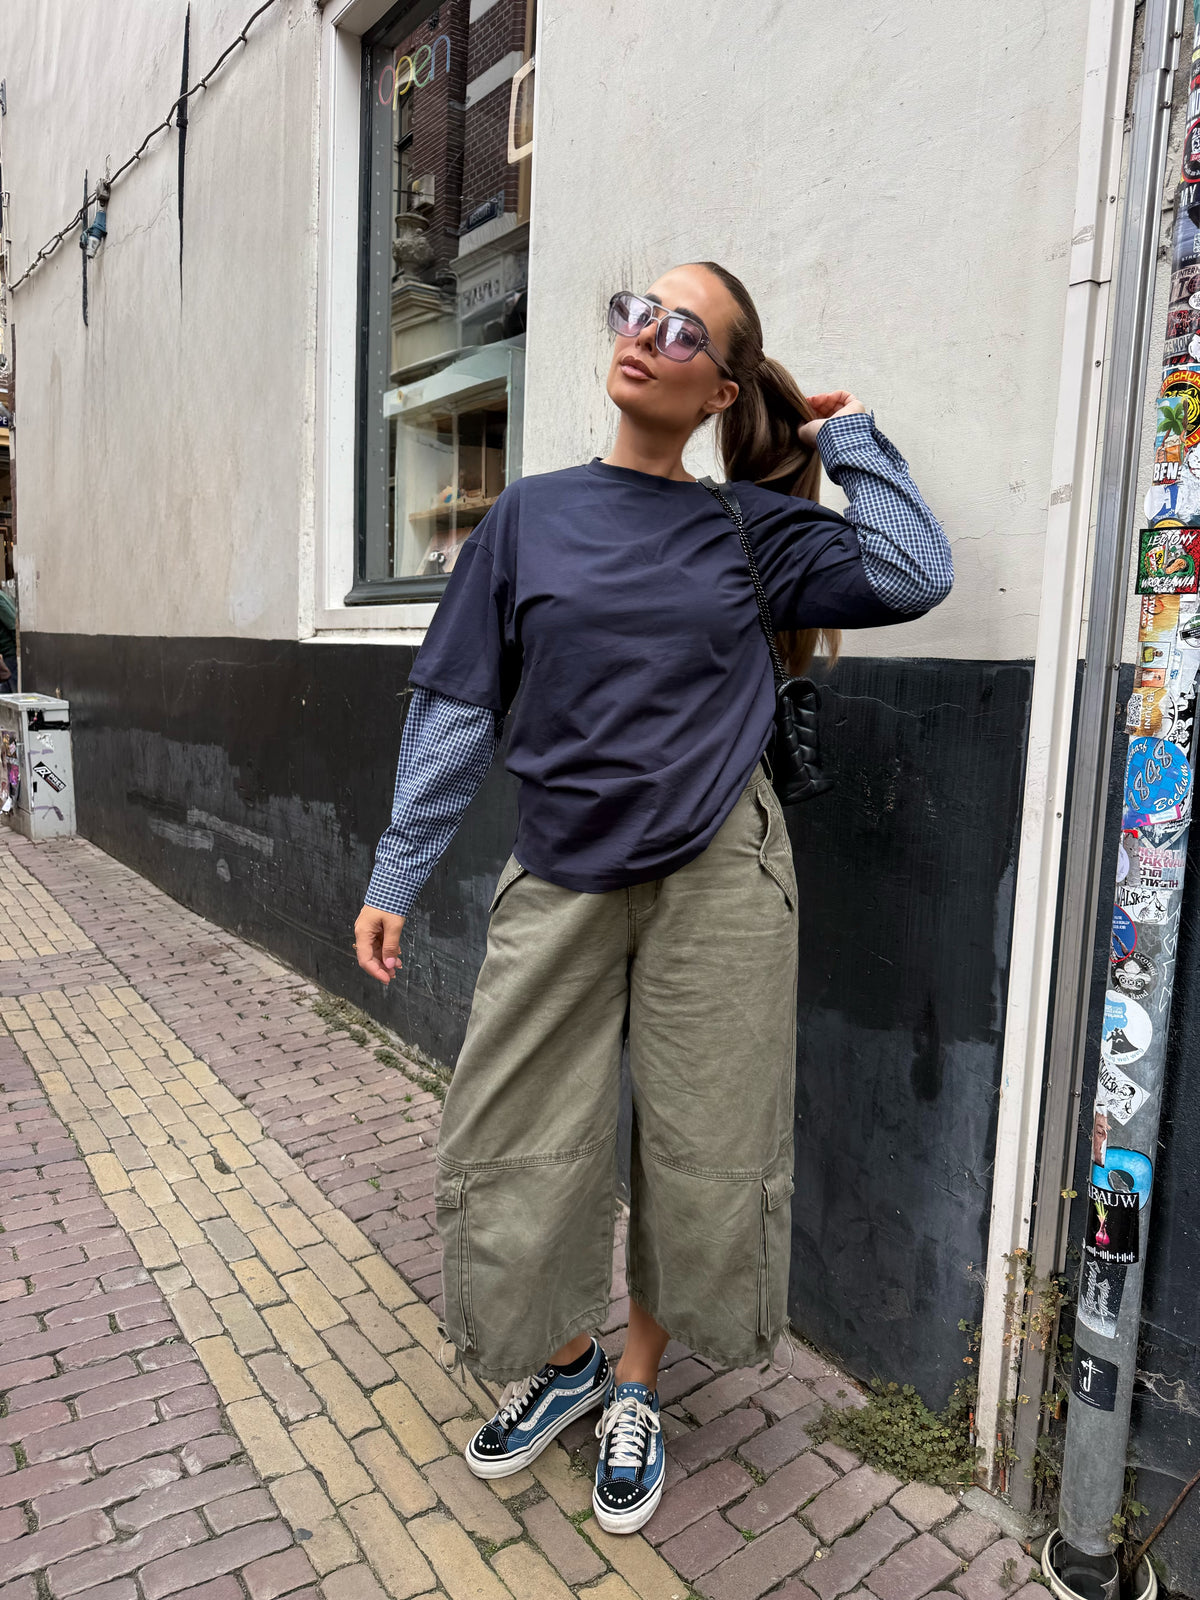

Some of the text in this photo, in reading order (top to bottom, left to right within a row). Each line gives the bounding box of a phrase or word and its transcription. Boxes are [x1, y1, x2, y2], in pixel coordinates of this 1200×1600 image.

[378, 35, 450, 111] open
[1127, 739, 1172, 811] 1848
[1153, 763, 1188, 811] Bochum
